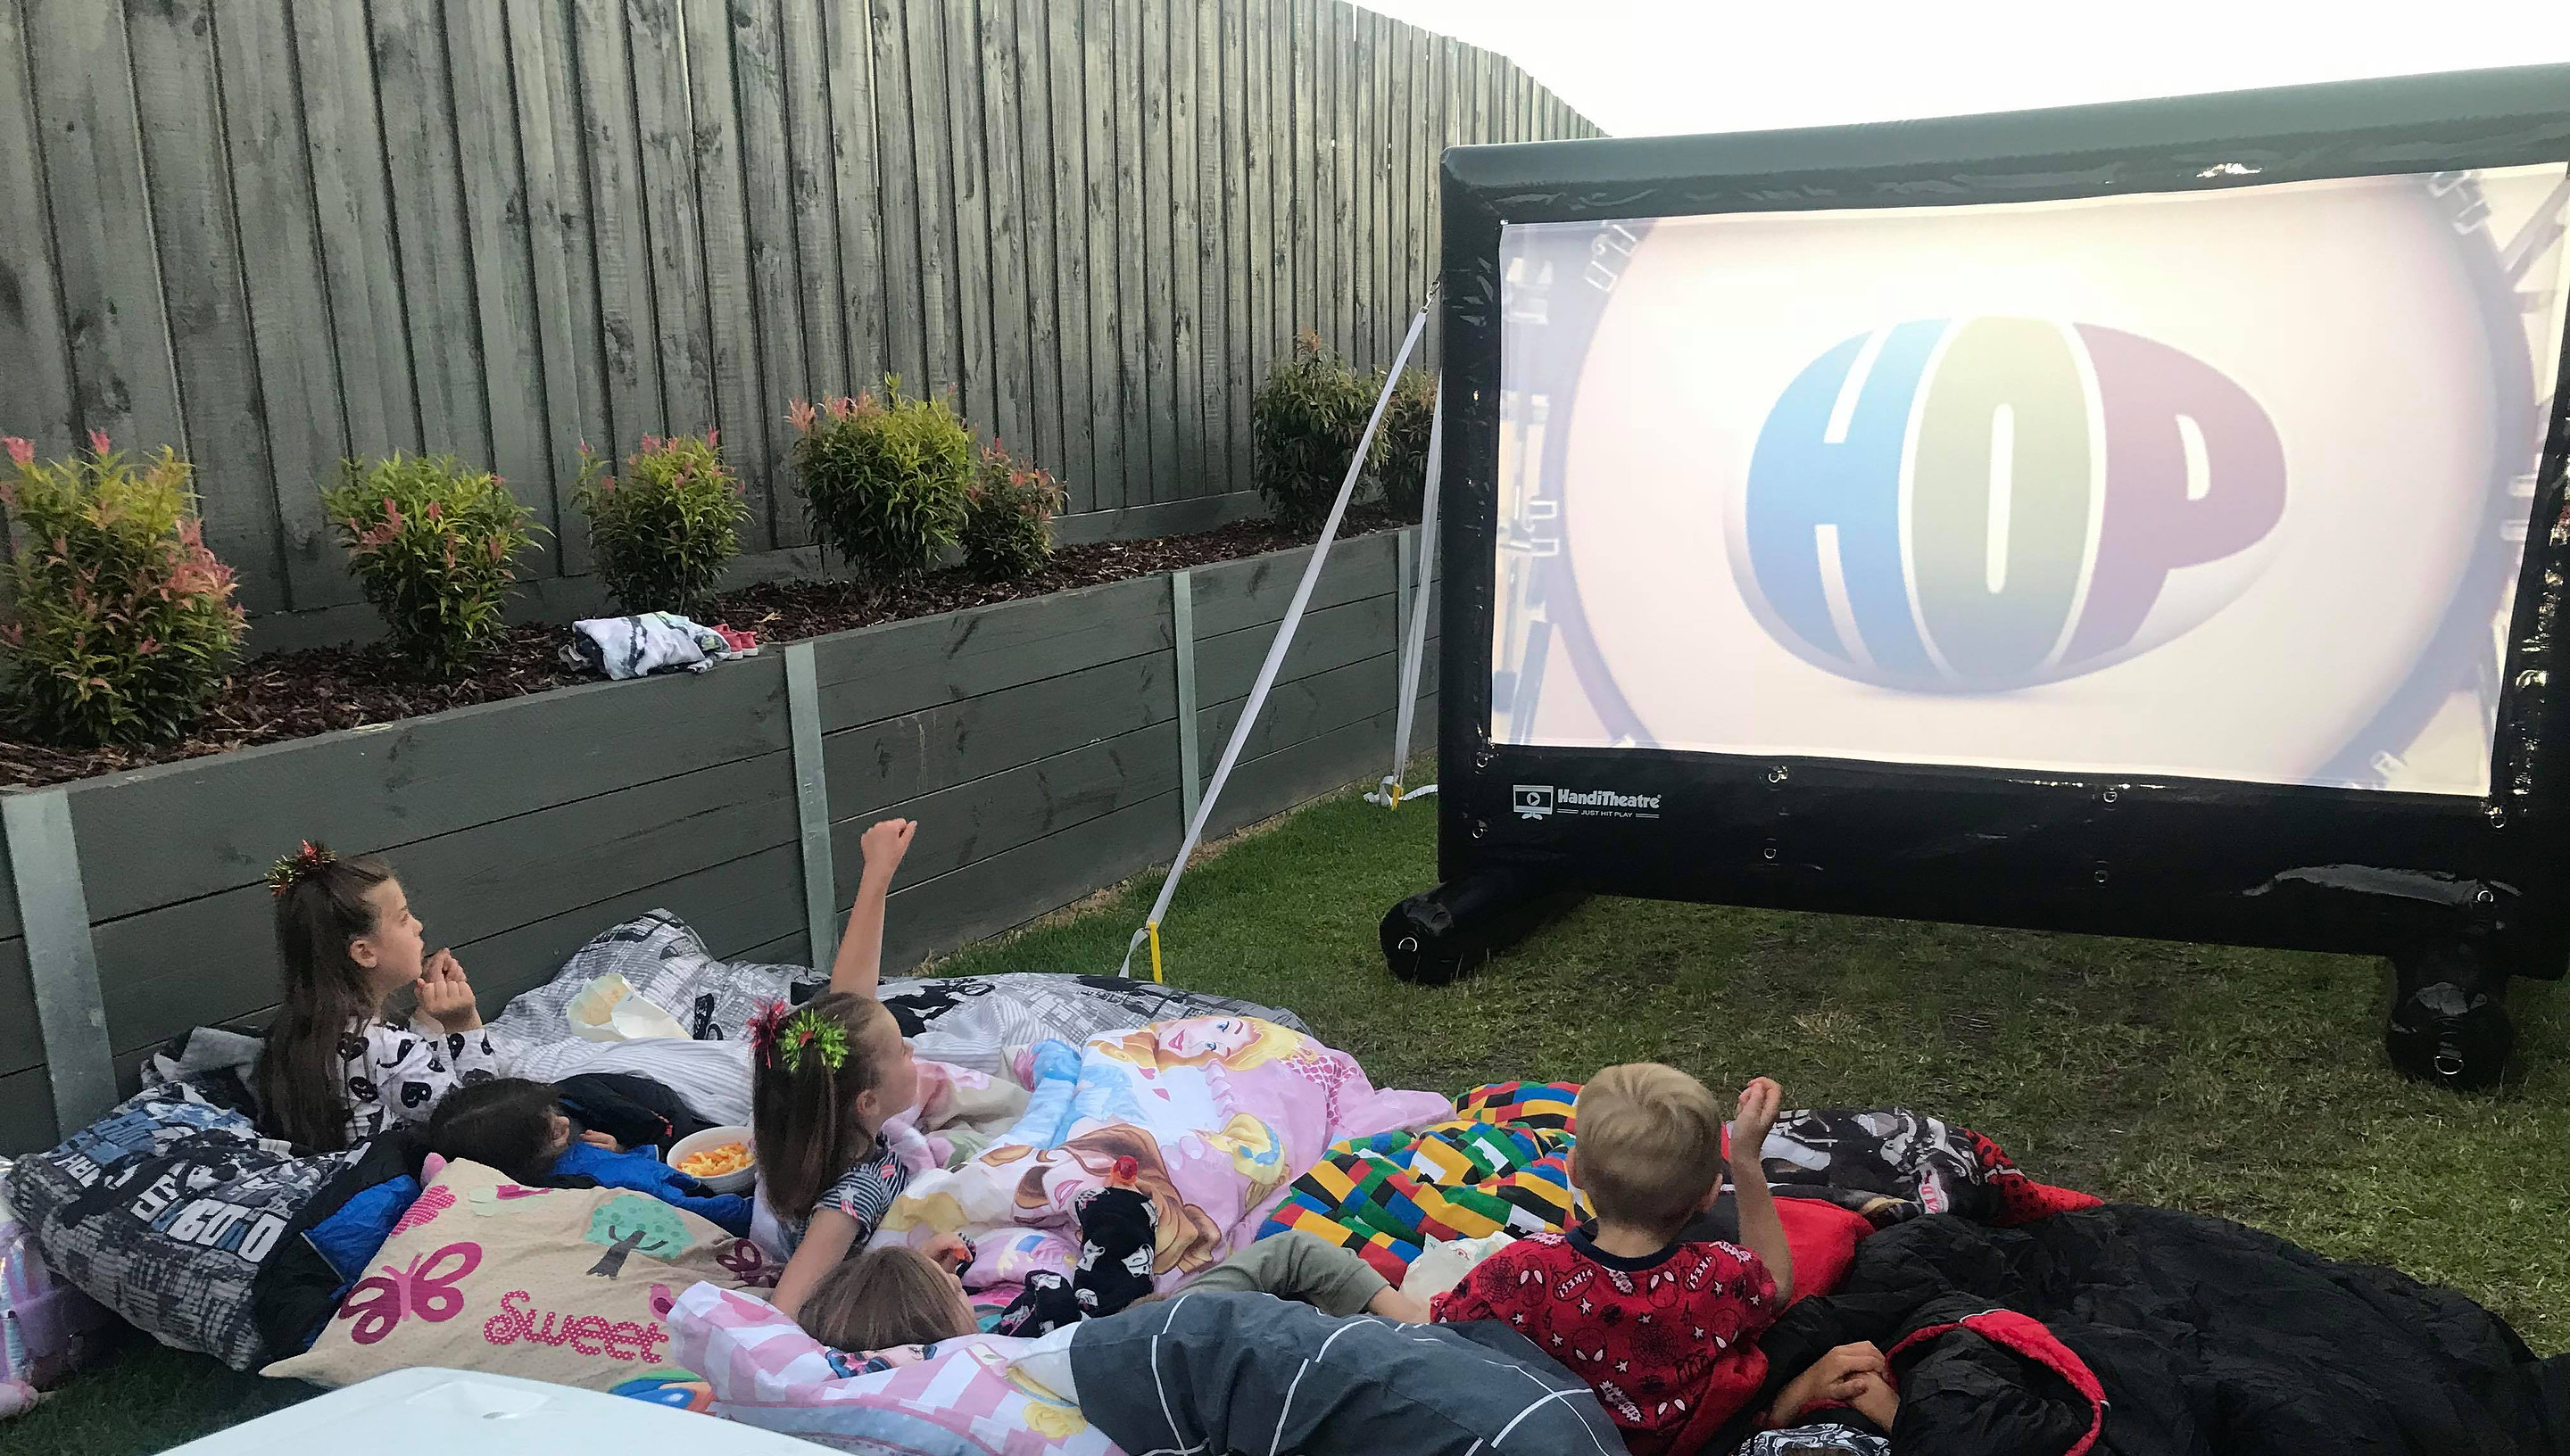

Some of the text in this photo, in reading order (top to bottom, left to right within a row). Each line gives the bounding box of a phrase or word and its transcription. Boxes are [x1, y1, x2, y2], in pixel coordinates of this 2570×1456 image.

[1746, 315, 2288, 682] HOP
[1557, 789, 1661, 808] HandiTheatre
[483, 1290, 669, 1364] Sweet
